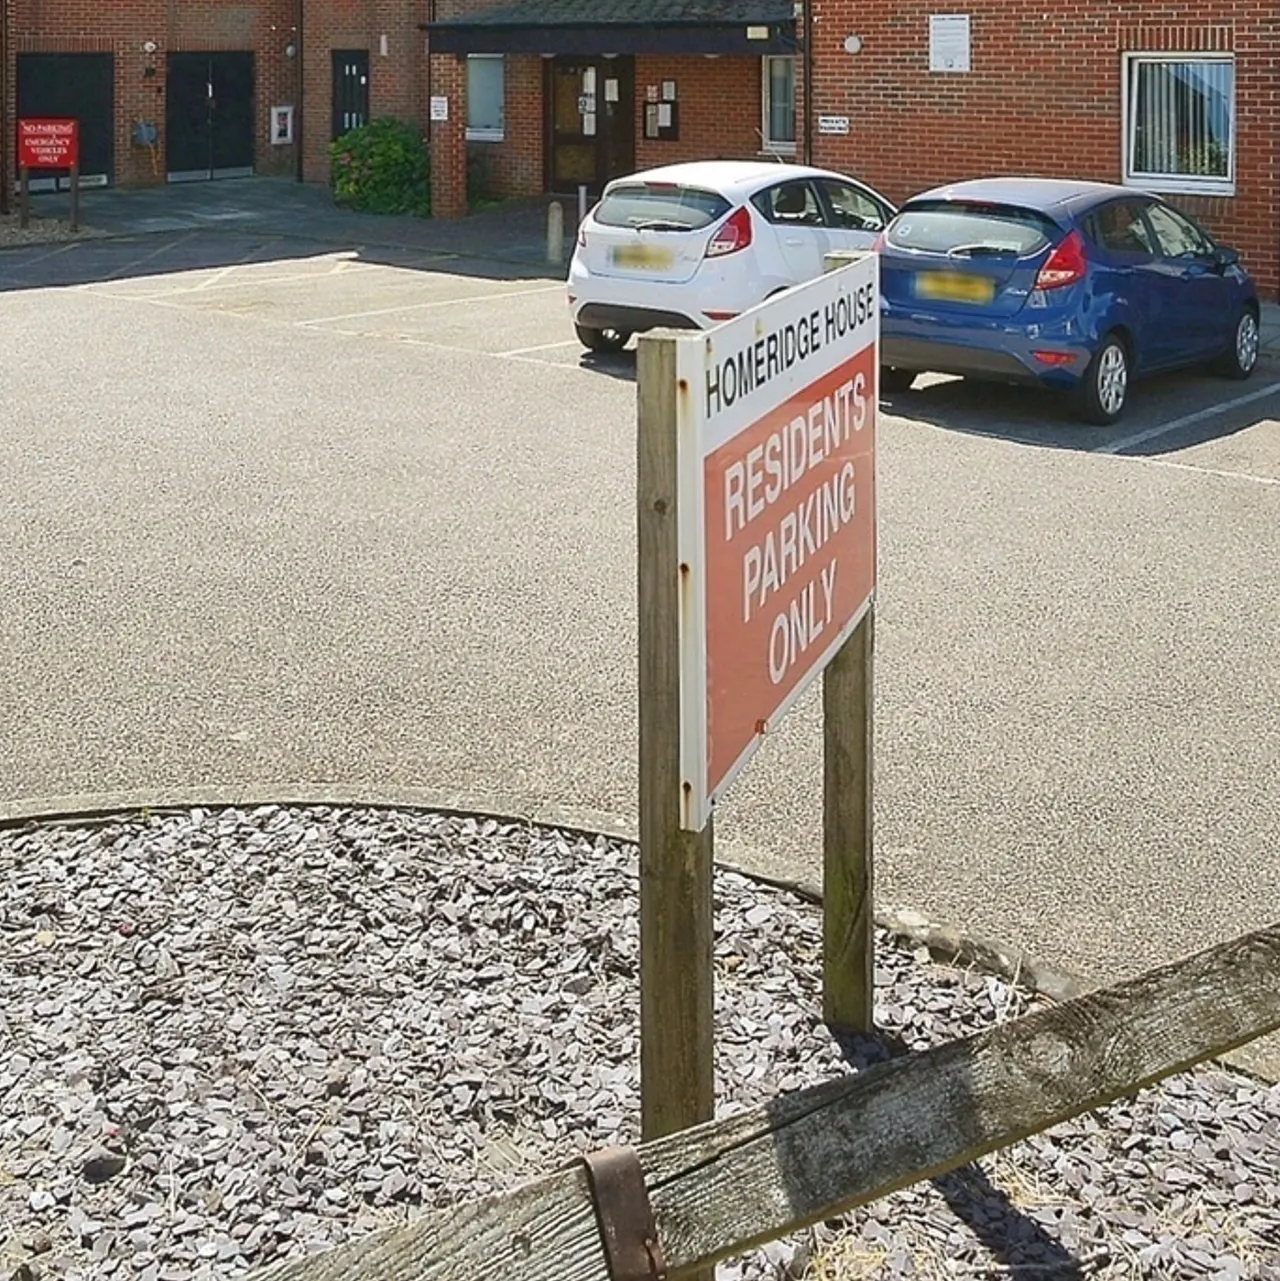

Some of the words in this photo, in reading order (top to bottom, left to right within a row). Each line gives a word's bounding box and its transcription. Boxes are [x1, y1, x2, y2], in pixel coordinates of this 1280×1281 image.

[705, 308, 820, 419] HOMERIDGE
[824, 280, 875, 357] HOUSE
[724, 373, 867, 541] RESIDENTS
[743, 462, 857, 624] PARKING
[767, 559, 838, 685] ONLY
